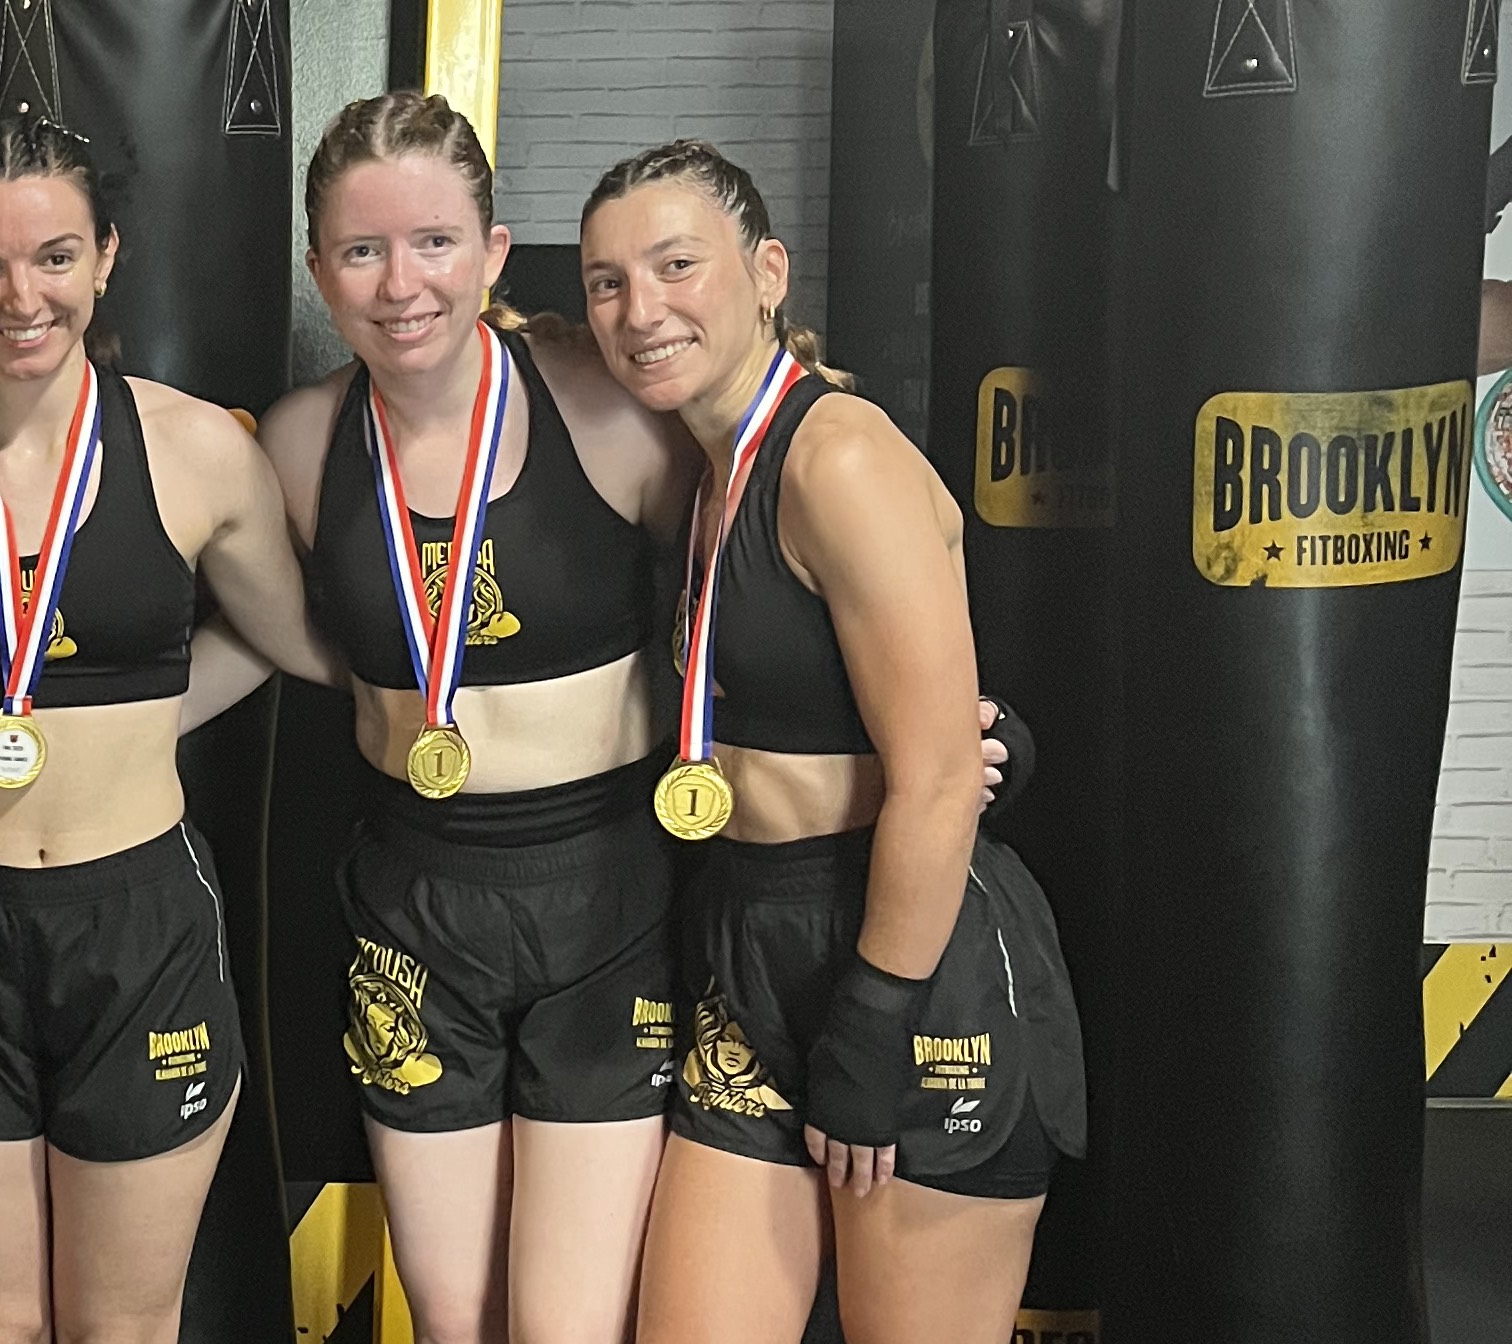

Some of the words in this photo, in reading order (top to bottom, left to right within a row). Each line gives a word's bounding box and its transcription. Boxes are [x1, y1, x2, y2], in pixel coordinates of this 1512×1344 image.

[1212, 401, 1468, 533] BROOKLYN
[1295, 528, 1411, 566] FITBOXING
[686, 788, 700, 817] 1
[148, 1020, 210, 1061] BROOKLYN
[913, 1032, 992, 1066] BROOKLYN
